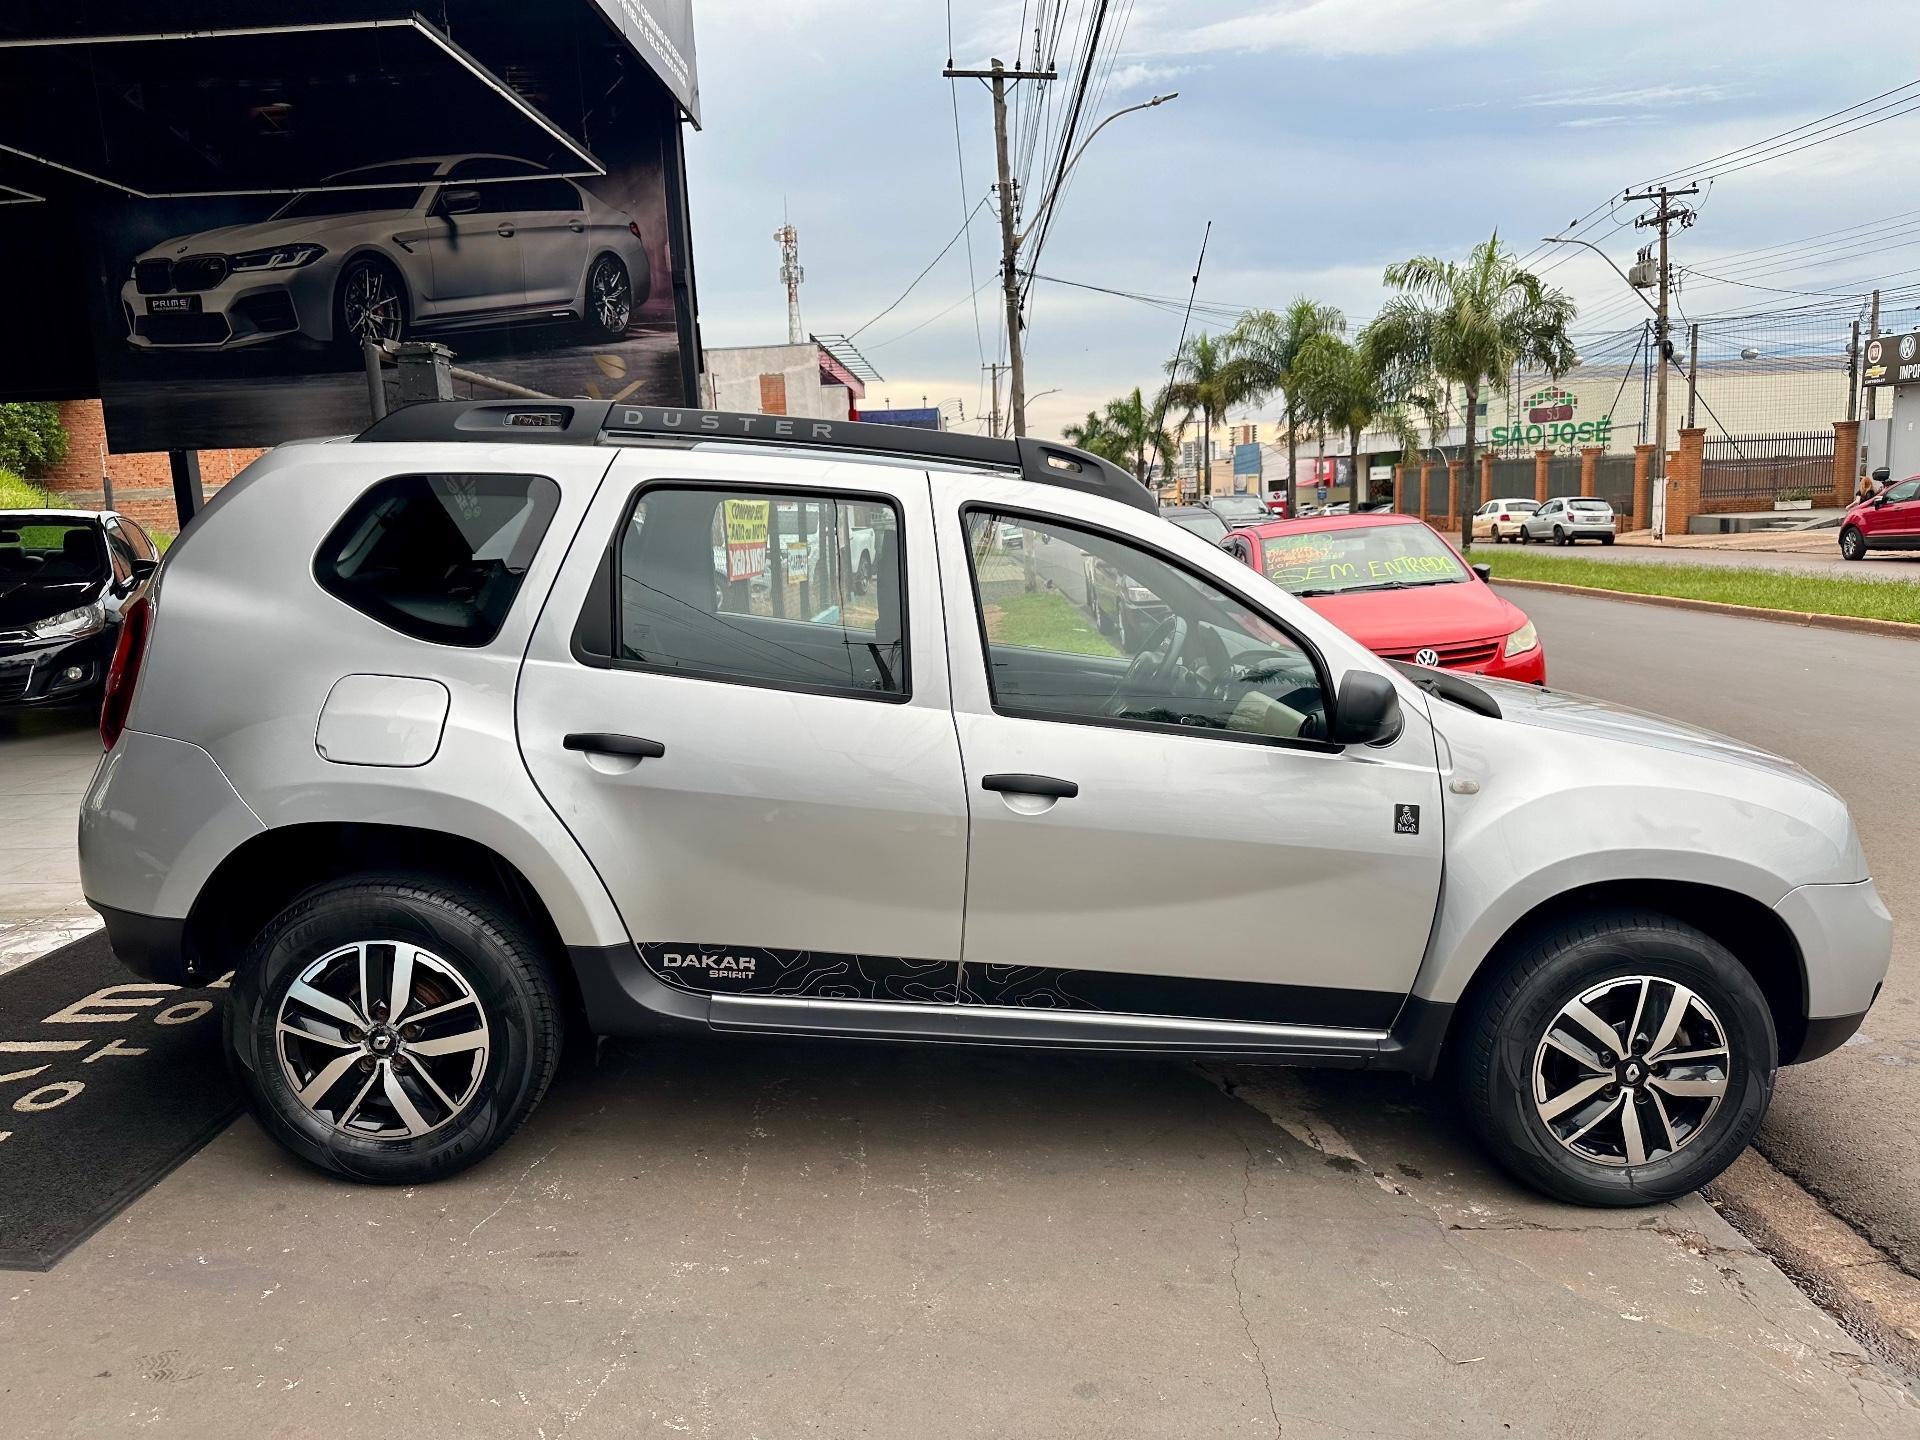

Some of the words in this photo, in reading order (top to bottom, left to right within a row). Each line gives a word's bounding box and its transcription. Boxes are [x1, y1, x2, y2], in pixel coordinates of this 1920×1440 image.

[152, 299, 187, 308] PRIME
[624, 410, 833, 439] DUSTER
[1491, 421, 1543, 447] SÃO
[1547, 414, 1612, 445] JOSÉ
[1368, 555, 1457, 578] ENTRADA
[663, 953, 756, 971] DAKAR
[709, 969, 755, 979] SPIRIT
